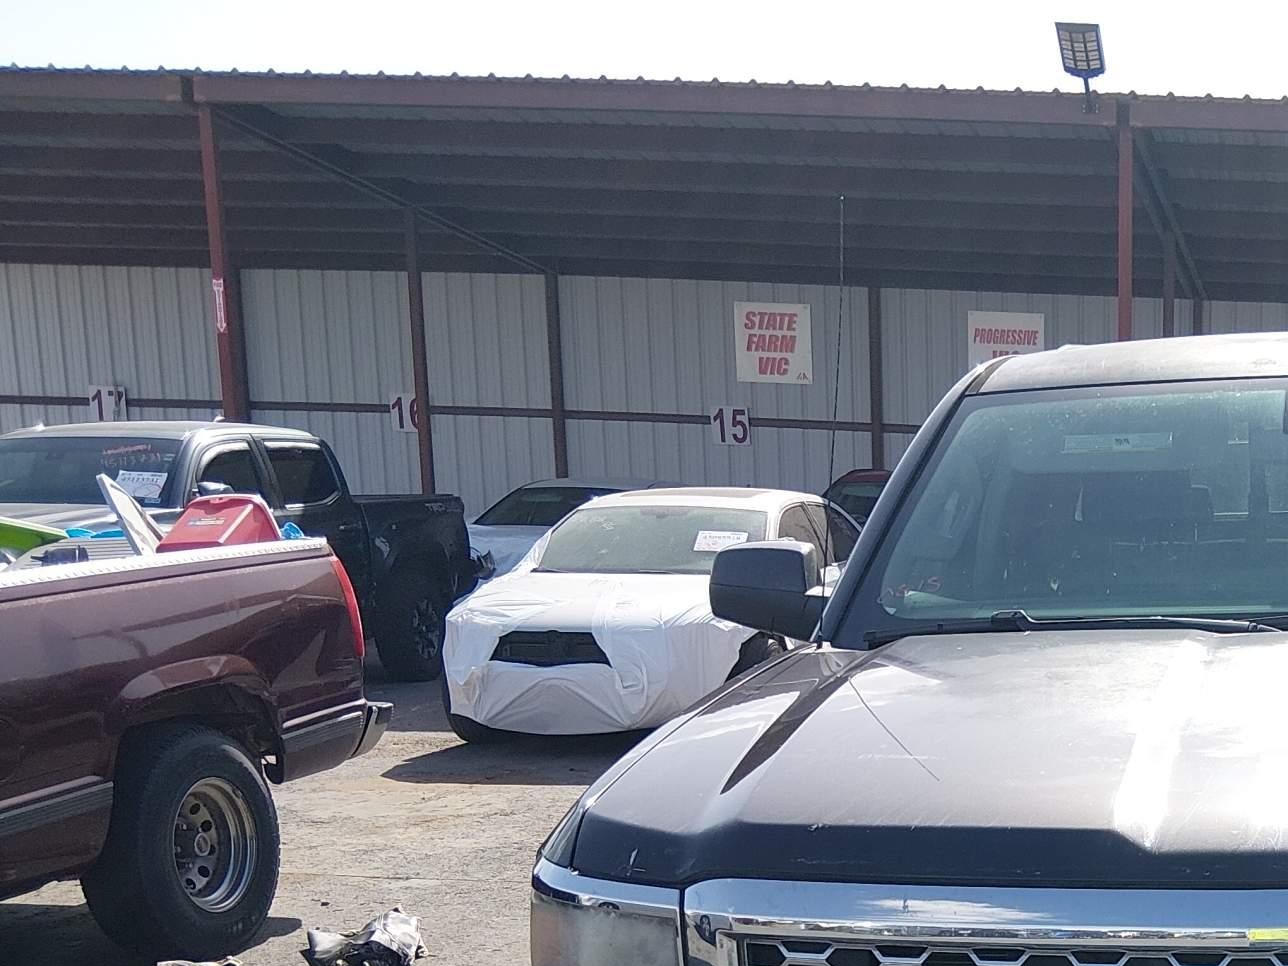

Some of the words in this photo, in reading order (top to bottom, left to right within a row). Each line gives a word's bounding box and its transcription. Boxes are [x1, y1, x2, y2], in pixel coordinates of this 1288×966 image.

[744, 311, 798, 331] STATE
[746, 333, 797, 353] FARM
[974, 328, 1039, 346] PROGRESSIVE
[758, 357, 790, 376] VIC
[713, 408, 748, 443] 15
